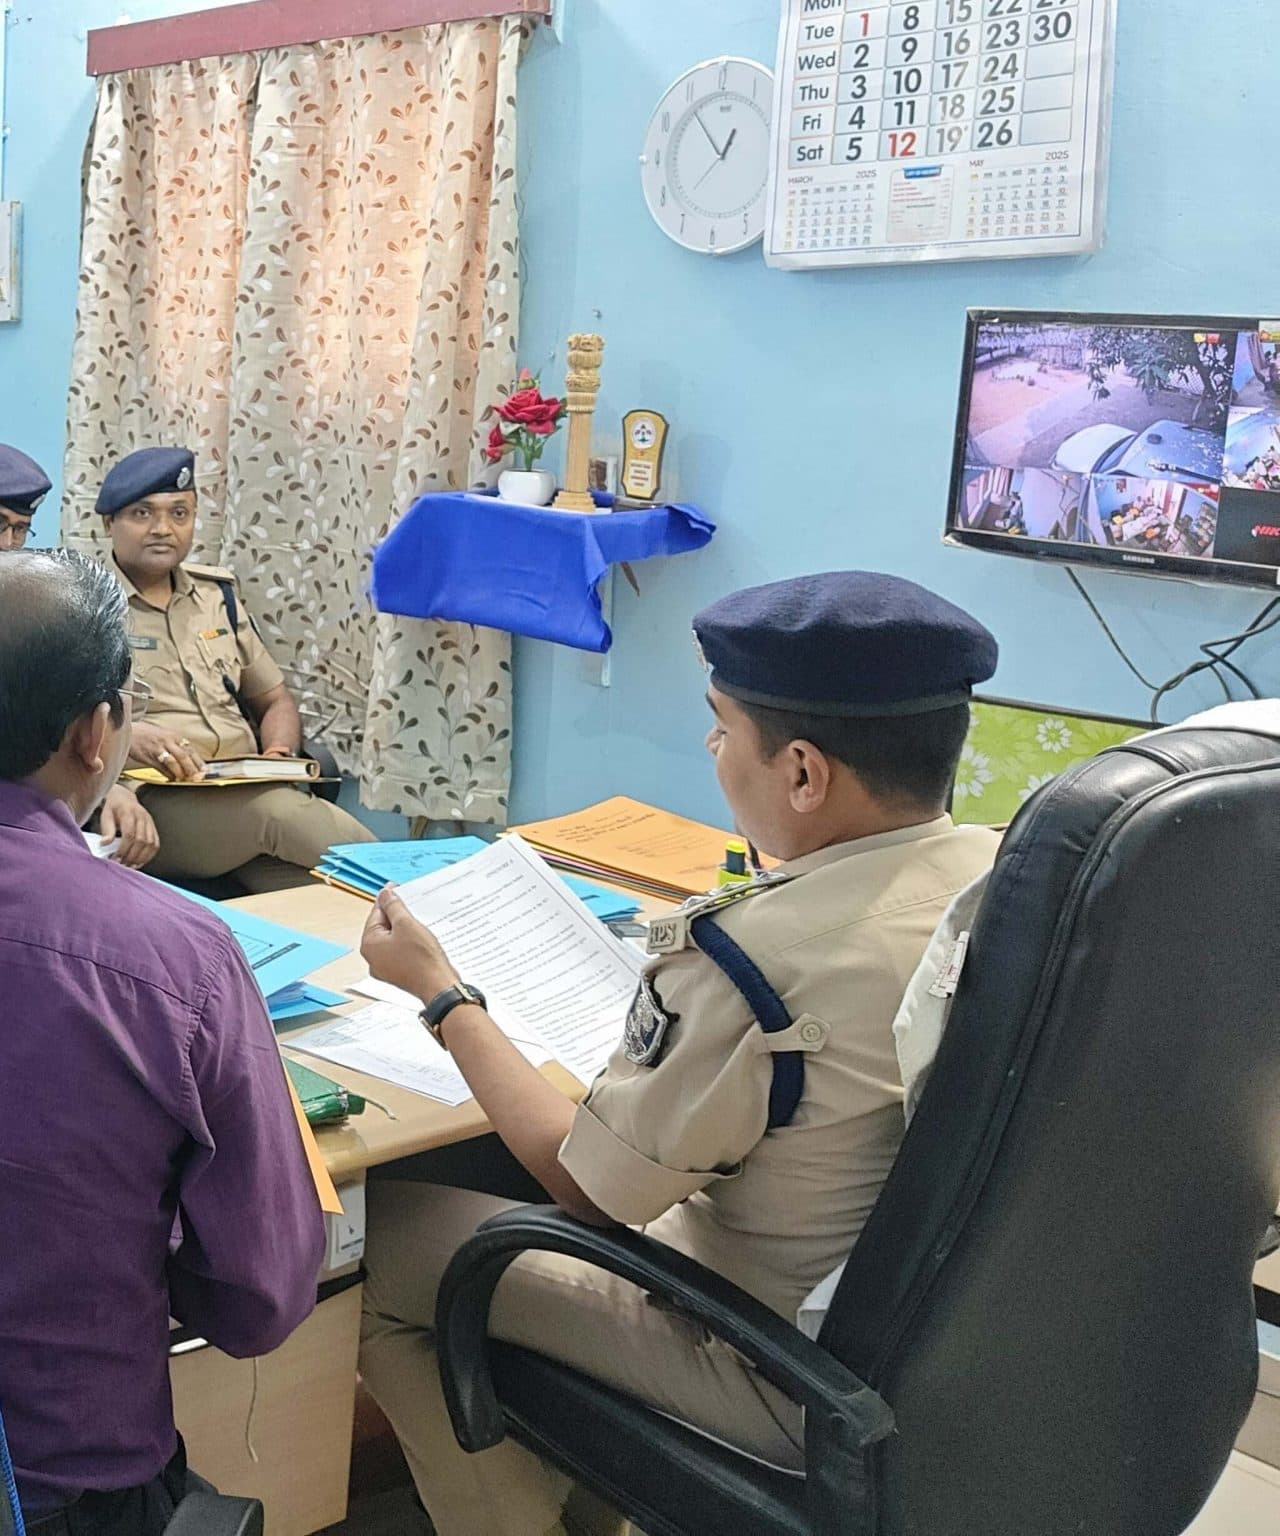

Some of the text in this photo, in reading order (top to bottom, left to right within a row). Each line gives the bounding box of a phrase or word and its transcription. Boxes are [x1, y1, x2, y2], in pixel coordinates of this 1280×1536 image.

[804, 0, 841, 12] Mon
[805, 25, 835, 40] Tue
[860, 13, 869, 37] 1
[903, 5, 919, 30] 8
[946, 0, 972, 24] 15
[798, 11, 1072, 71] Wed 2 9 16 23 30
[799, 53, 1019, 101] Thu 3 10 17 24
[802, 86, 1016, 131] Fri 4 11 18 25
[796, 119, 1013, 161] Sat 5 12 19 26
[969, 150, 1069, 168] MAY 2025
